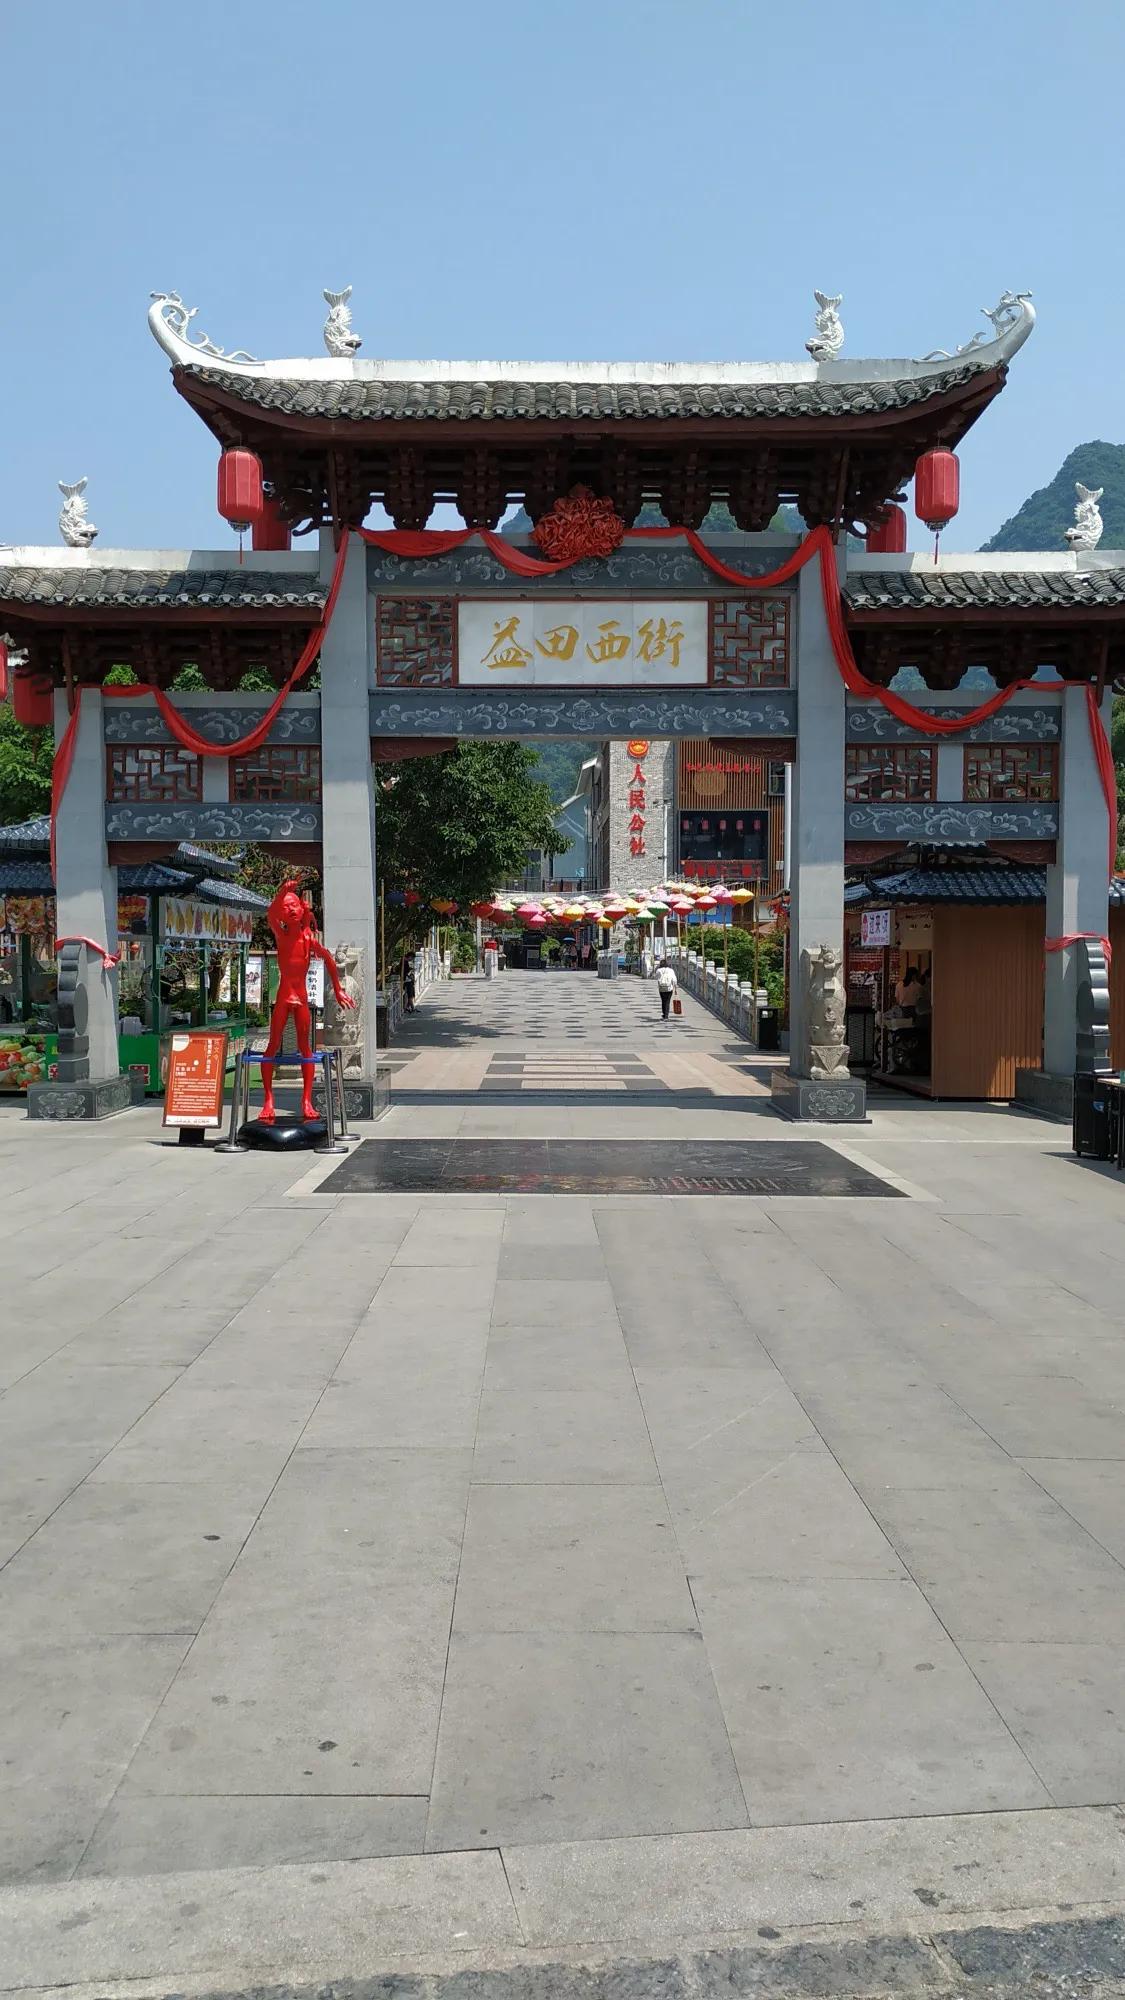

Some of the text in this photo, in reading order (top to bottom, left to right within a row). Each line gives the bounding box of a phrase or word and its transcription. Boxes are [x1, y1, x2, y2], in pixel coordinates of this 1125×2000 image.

[480, 616, 685, 670] 益田西街
[627, 763, 647, 857] 人民公社
